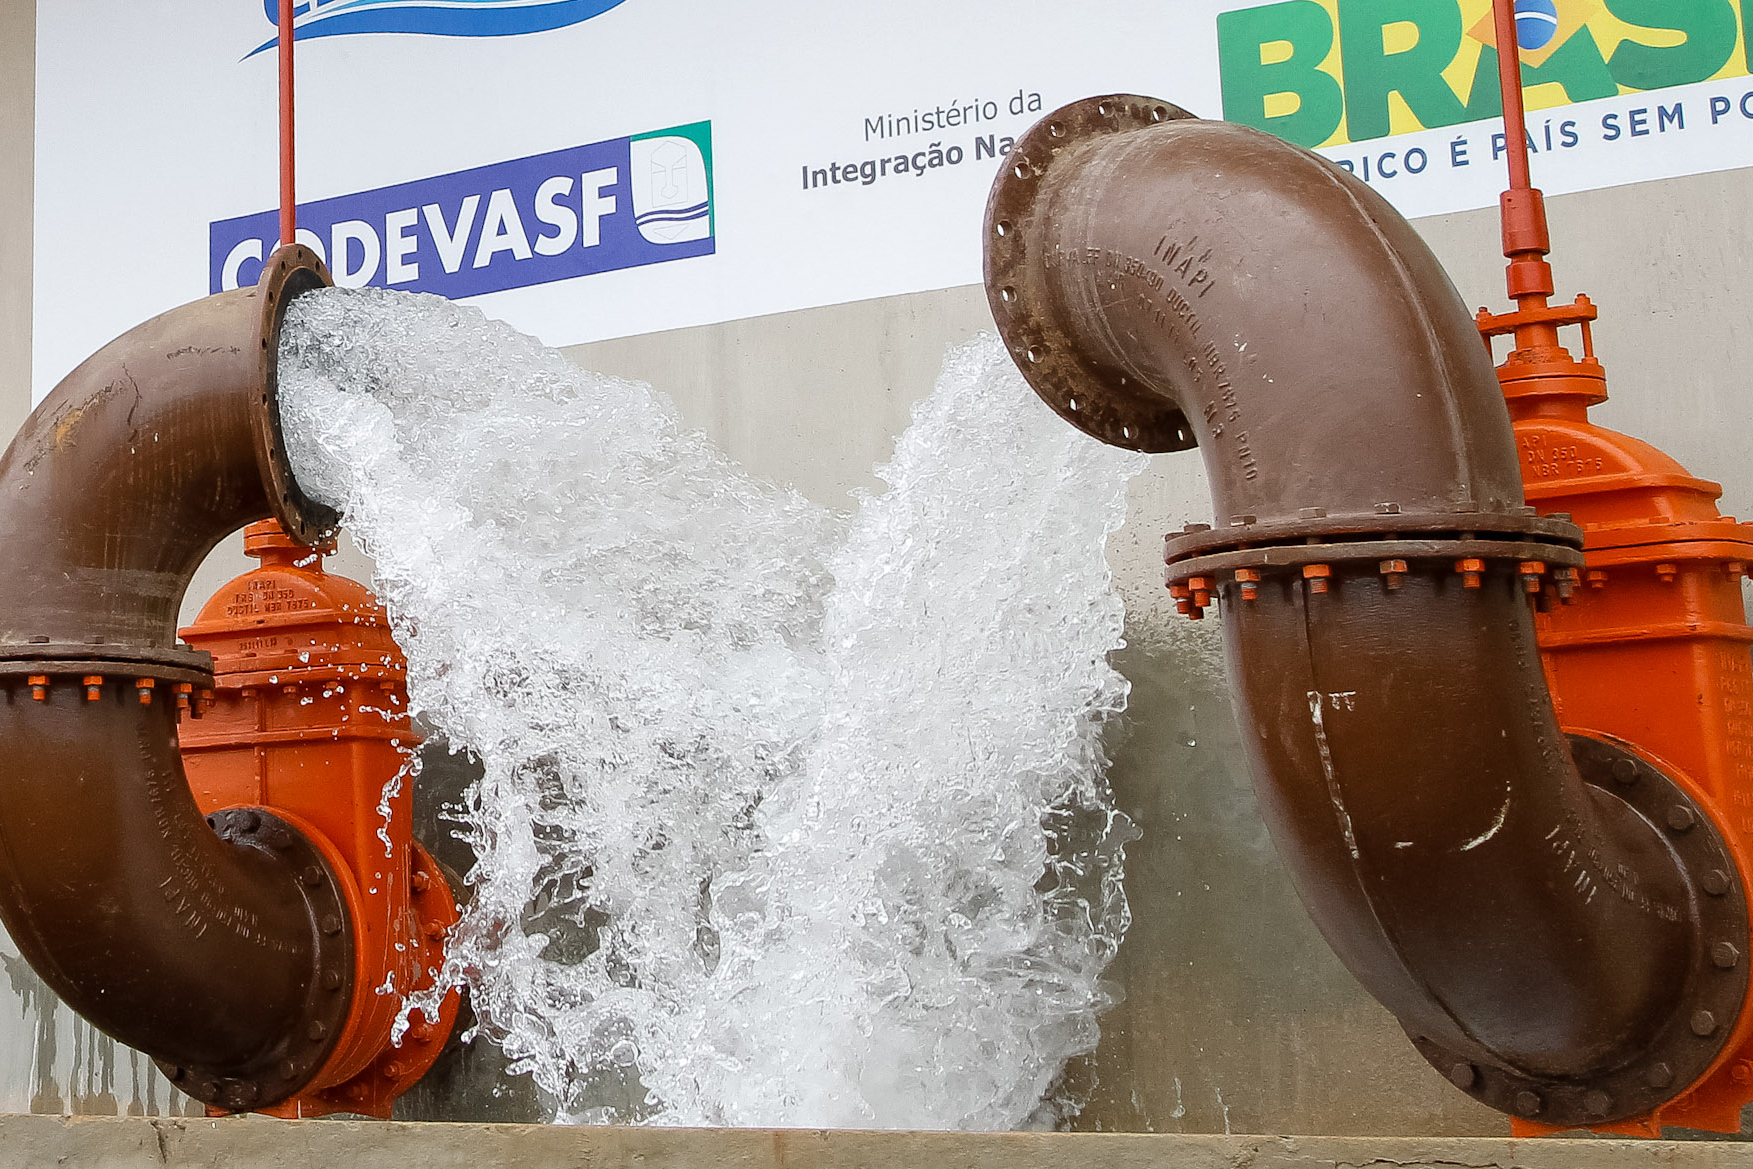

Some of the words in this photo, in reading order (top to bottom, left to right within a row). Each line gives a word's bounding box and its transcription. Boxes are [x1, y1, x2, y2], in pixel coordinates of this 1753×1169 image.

[863, 99, 998, 142] Ministério
[1009, 89, 1042, 116] da
[1450, 135, 1470, 168] É
[1602, 102, 1685, 141] SEM
[802, 141, 963, 190] Integração
